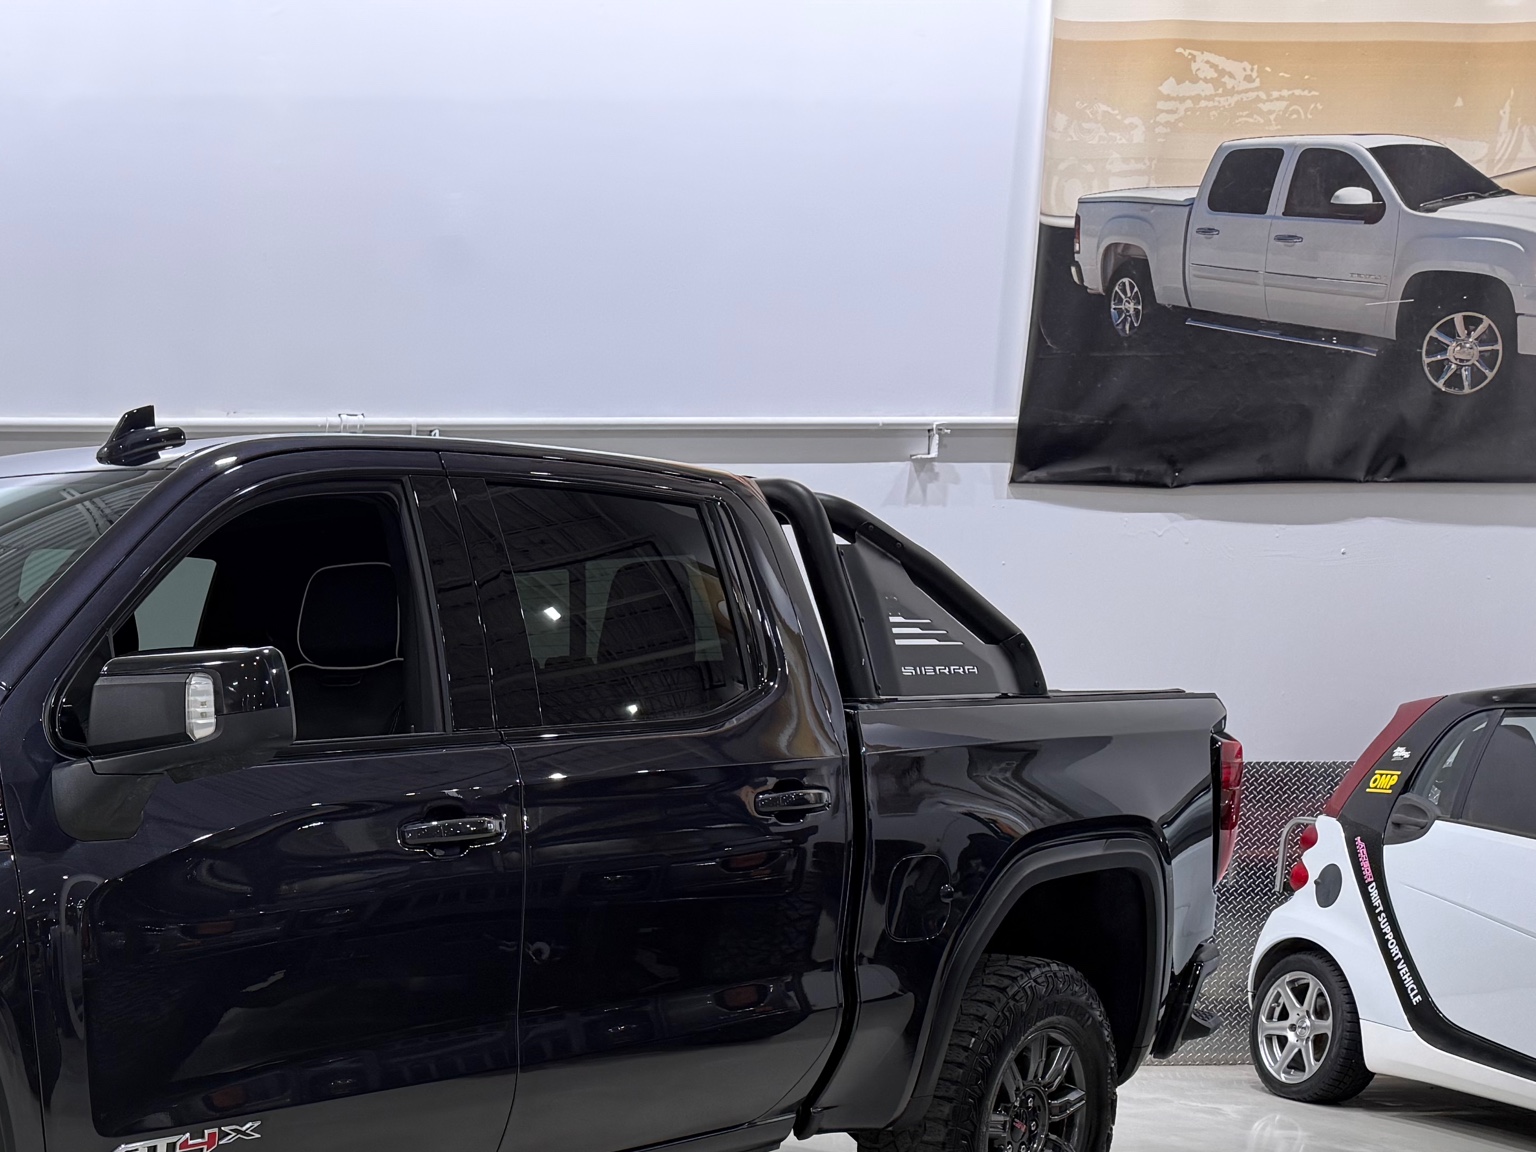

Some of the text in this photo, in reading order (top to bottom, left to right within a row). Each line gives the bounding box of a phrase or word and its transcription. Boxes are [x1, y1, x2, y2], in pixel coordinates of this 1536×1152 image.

[901, 665, 978, 676] SIERRA
[1369, 774, 1399, 789] OMP
[1367, 881, 1384, 913] DRIFT
[1377, 912, 1403, 961] SUPPORT
[1396, 959, 1423, 1006] VEHICLE
